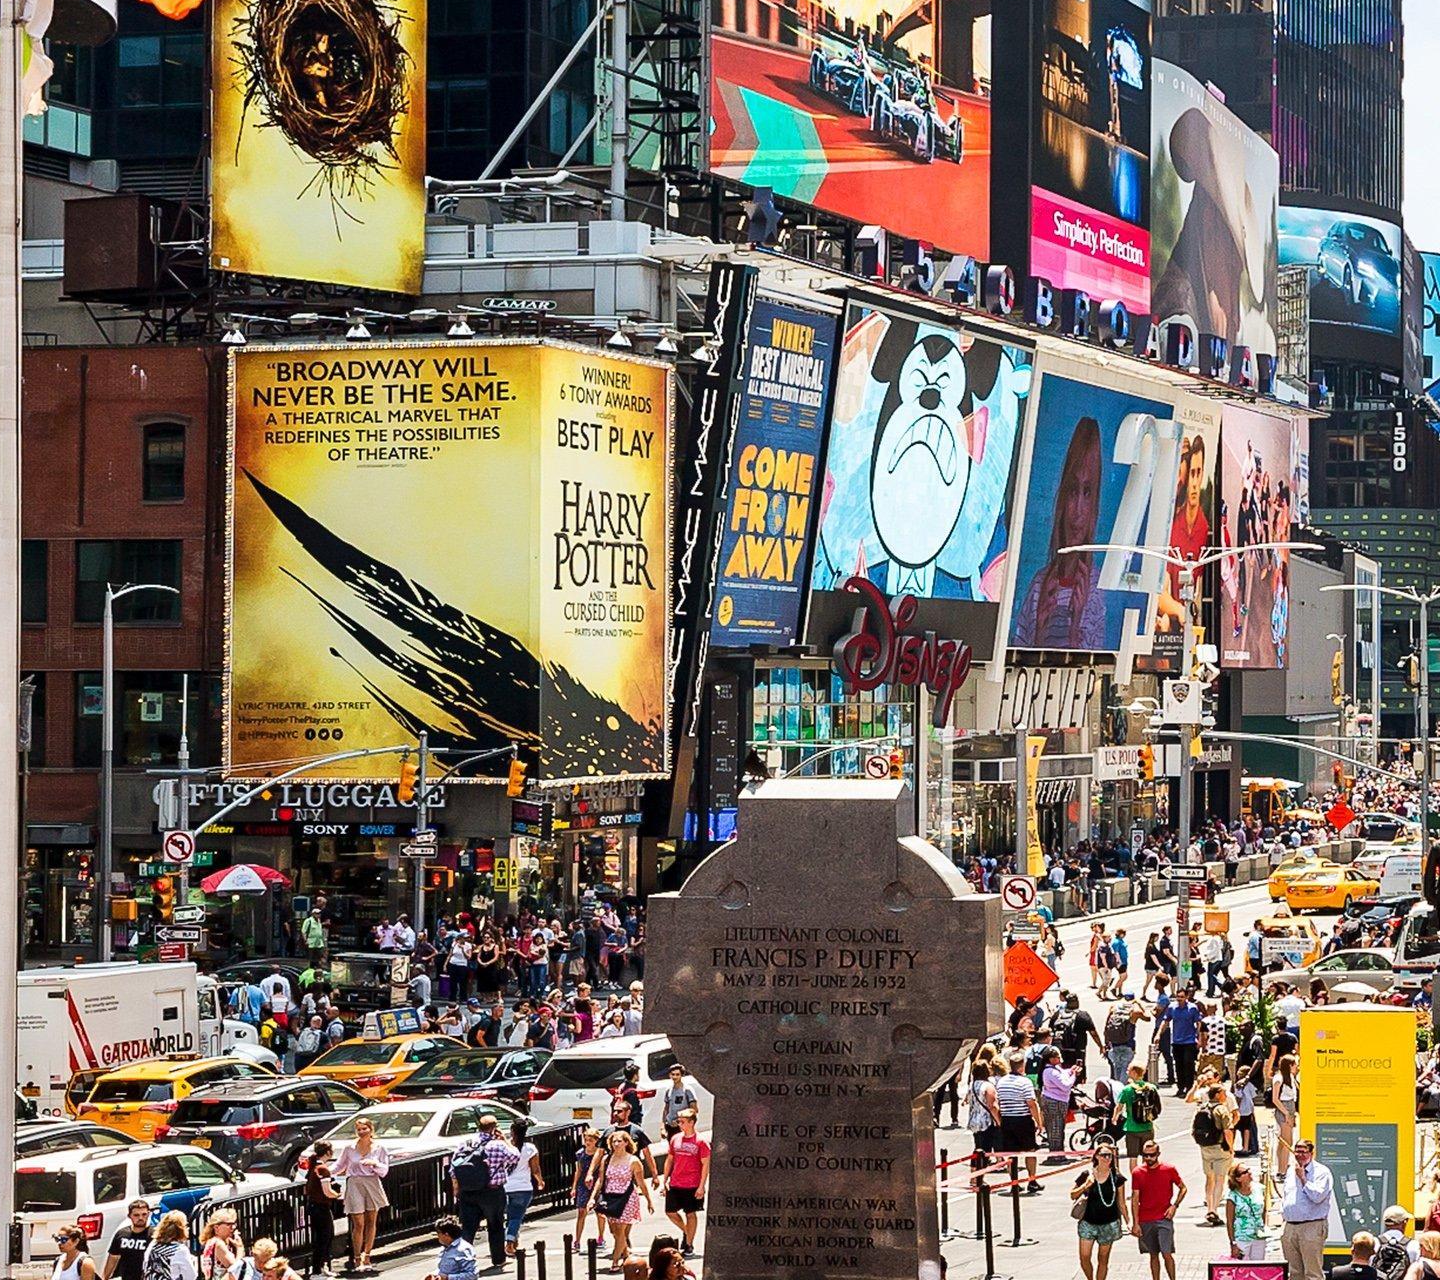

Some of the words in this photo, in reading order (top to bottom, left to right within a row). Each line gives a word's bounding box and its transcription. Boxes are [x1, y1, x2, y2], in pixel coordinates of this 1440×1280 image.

[487, 299, 553, 310] LAMAR
[771, 318, 815, 355] WINNER!
[431, 357, 497, 378] WILL
[750, 345, 780, 381] BEST
[779, 353, 825, 390] MUSICAL
[582, 366, 631, 388] WINNER!
[253, 388, 338, 407] NEVER
[344, 386, 376, 405] BE
[382, 385, 433, 404] THE
[439, 382, 517, 402] SAME.
[560, 385, 566, 401] 6
[569, 385, 601, 405] TONY
[604, 392, 652, 414] AWARDS
[265, 412, 277, 424] A
[281, 410, 383, 424] THEATRICAL
[387, 409, 454, 422] MARVEL
[457, 407, 501, 420] THAT
[265, 430, 350, 444] REDEFINES
[355, 429, 388, 443] THE
[393, 426, 500, 441] POSSIBILITIES
[557, 418, 602, 452] BEST
[608, 425, 655, 459] PLAY
[1394, 411, 1406, 473] 1500
[328, 449, 351, 462] OF
[739, 444, 816, 489] COME
[559, 480, 651, 541] HARRY
[731, 488, 810, 536] FROM
[553, 532, 657, 590] POTTER
[723, 538, 805, 583] AWAY
[563, 602, 607, 624] CURSED
[609, 604, 645, 624] CHILD
[238, 702, 263, 711] LYRIC
[312, 701, 334, 710] 43RD
[337, 701, 371, 710] STREET
[996, 667, 1098, 730] FOREVER
[599, 814, 623, 826] SONY
[497, 861, 507, 887] ATM
[724, 928, 822, 942] LIEUTENANT
[825, 927, 900, 942] COLONEL
[711, 948, 807, 969] FRANCIS
[838, 949, 920, 970] DUFFY
[1009, 956, 1035, 965] ROAD
[722, 975, 754, 988] MAY
[758, 975, 766, 987] 2
[852, 974, 871, 987] 26
[873, 974, 906, 988] 1932
[1004, 977, 1036, 986] AHEAD
[738, 1000, 824, 1016] CATHOLIC
[830, 1001, 891, 1016] PRIEST
[773, 1040, 853, 1054] CHAPLAIN
[736, 1063, 780, 1077] 165TH
[1317, 1056, 1392, 1069] Unmoored
[756, 1084, 790, 1096] OLD
[794, 1084, 831, 1097] 69TH
[738, 1125, 748, 1138] A
[754, 1125, 791, 1138] LIFE
[795, 1125, 817, 1138] OF
[823, 1124, 890, 1139] SERVICE
[797, 1142, 825, 1154] FOR
[730, 1156, 766, 1170] GOD
[770, 1156, 810, 1170] AND
[815, 1156, 896, 1172] COUNTRY
[726, 1196, 782, 1209] SPANISH
[786, 1198, 860, 1211] AMERICAN
[865, 1199, 897, 1211] WAR
[761, 1254, 819, 1267] WORLD
[826, 1254, 858, 1268] WAR
